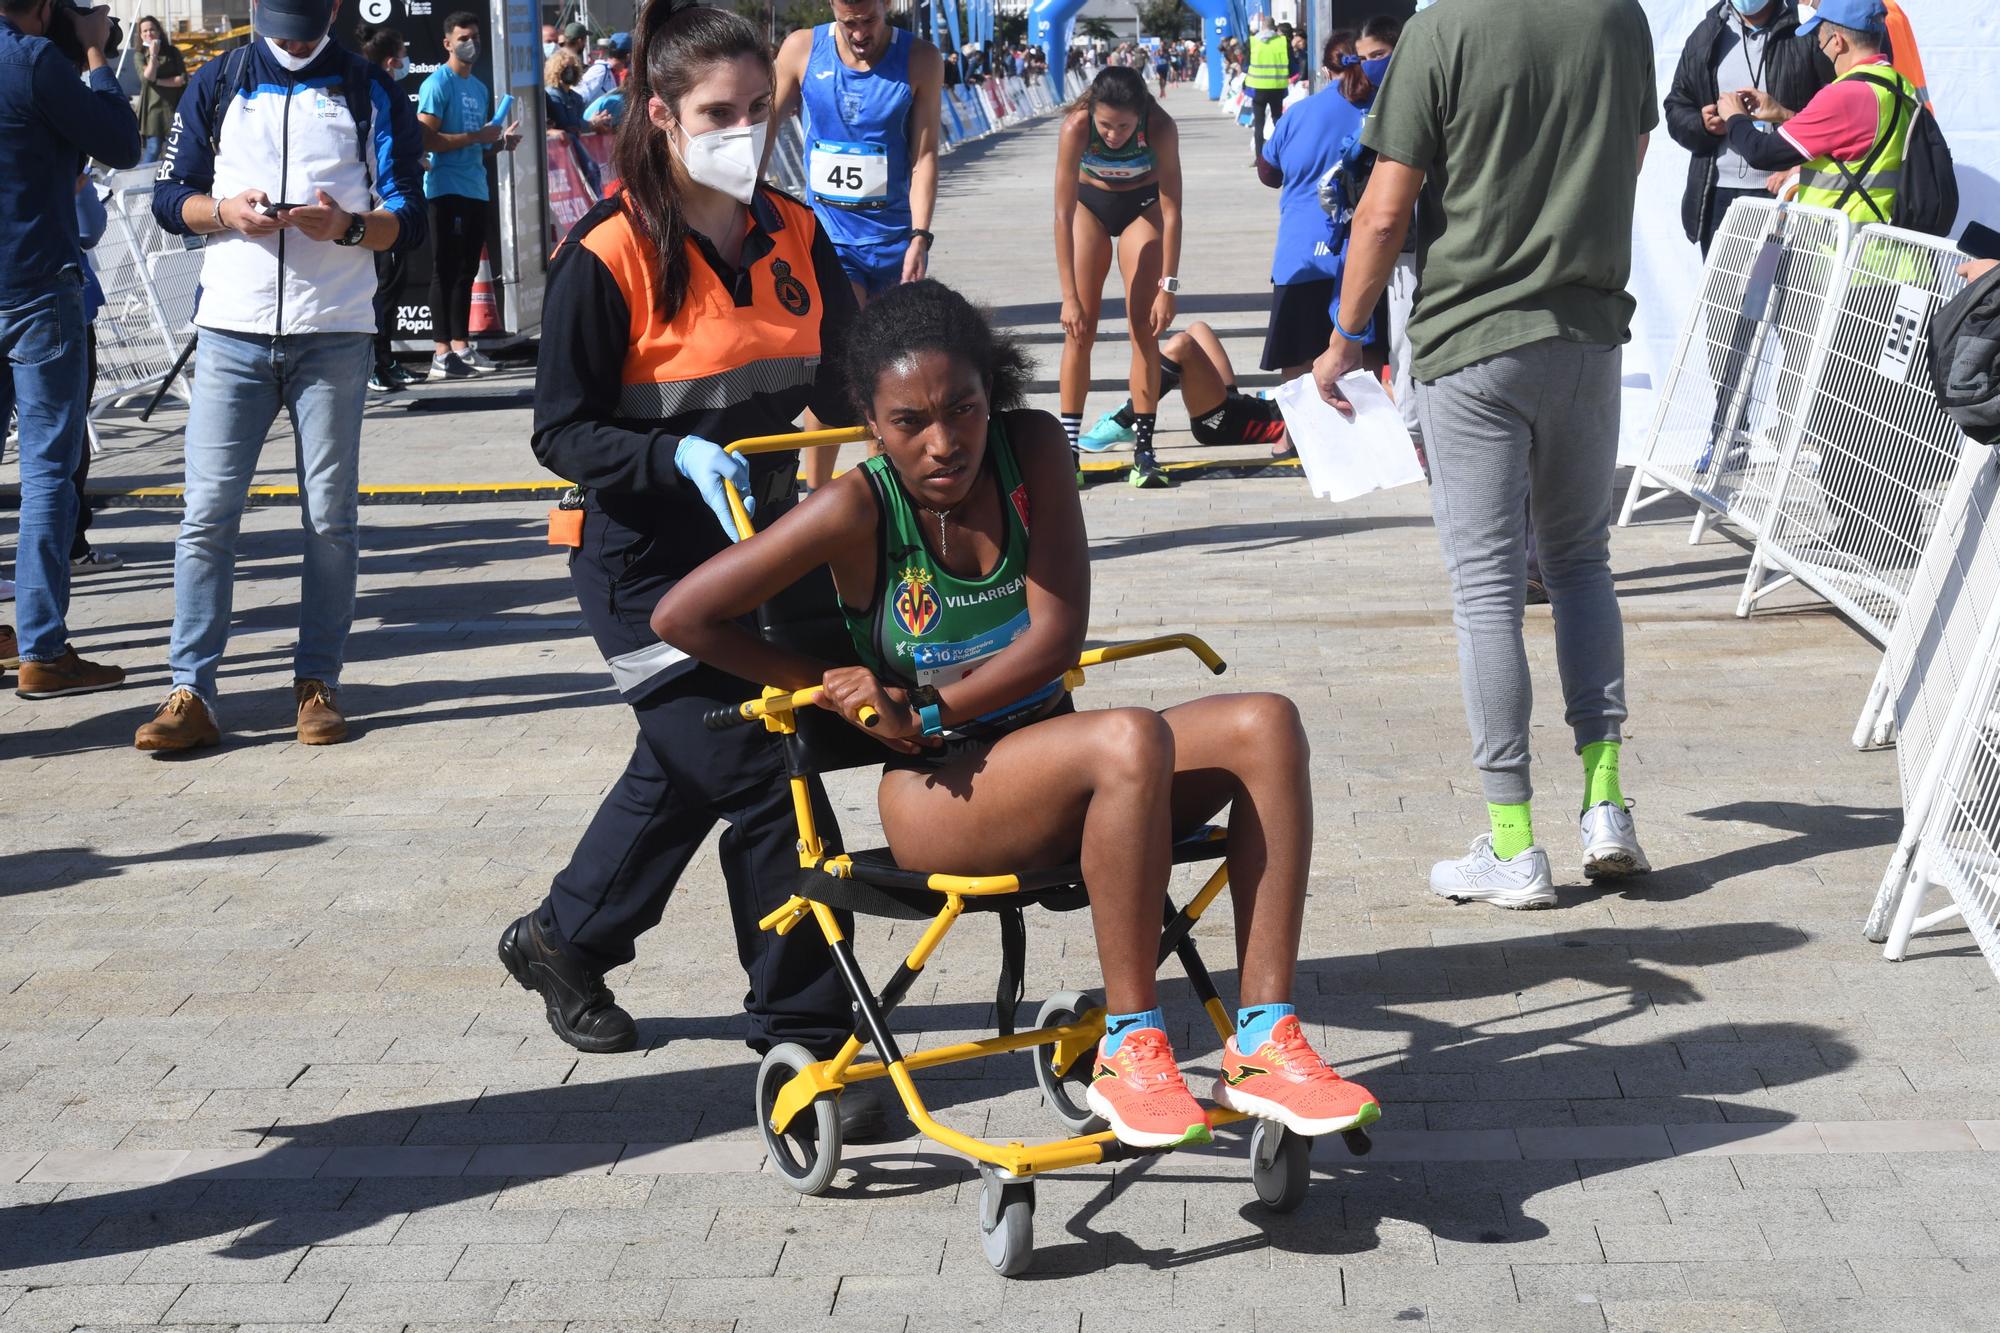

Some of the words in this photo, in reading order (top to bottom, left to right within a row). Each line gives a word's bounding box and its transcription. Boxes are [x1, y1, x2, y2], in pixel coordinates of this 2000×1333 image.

[827, 165, 863, 190] 45
[396, 305, 419, 318] XV
[418, 305, 432, 318] C
[397, 318, 433, 334] Popu
